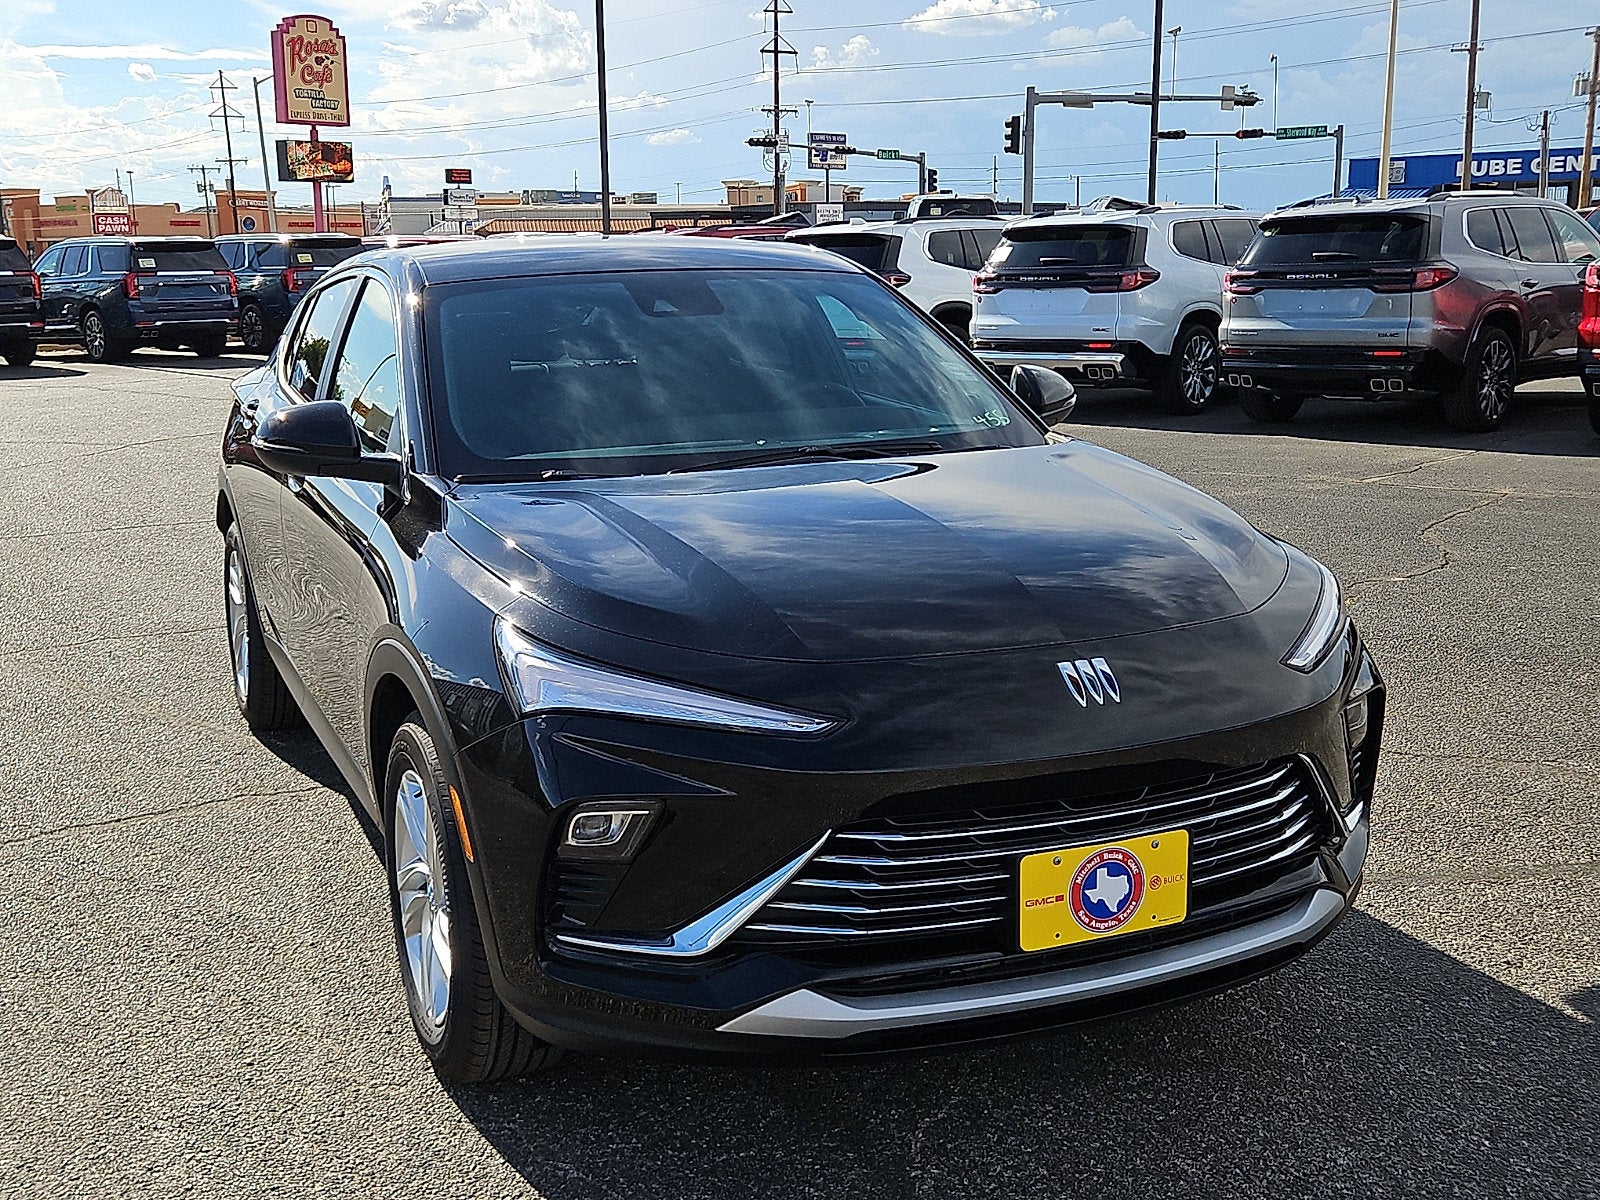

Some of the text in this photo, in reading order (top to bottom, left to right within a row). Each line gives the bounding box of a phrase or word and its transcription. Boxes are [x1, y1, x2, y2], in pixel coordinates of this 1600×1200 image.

[286, 34, 339, 76] Rosa's
[294, 89, 325, 99] TORTILLA
[311, 99, 339, 109] FACTORY
[1286, 128, 1307, 138] Sherwood
[1307, 127, 1317, 138] Way
[1456, 158, 1522, 177] LUBE
[98, 216, 128, 224] CASH
[97, 224, 129, 232] PAWN
[1075, 851, 1139, 885] Mitchell Buick GMC
[1163, 874, 1185, 885] BUICK
[1025, 896, 1054, 907] GMC
[1077, 909, 1090, 924] San
[1118, 901, 1137, 922] Texas
